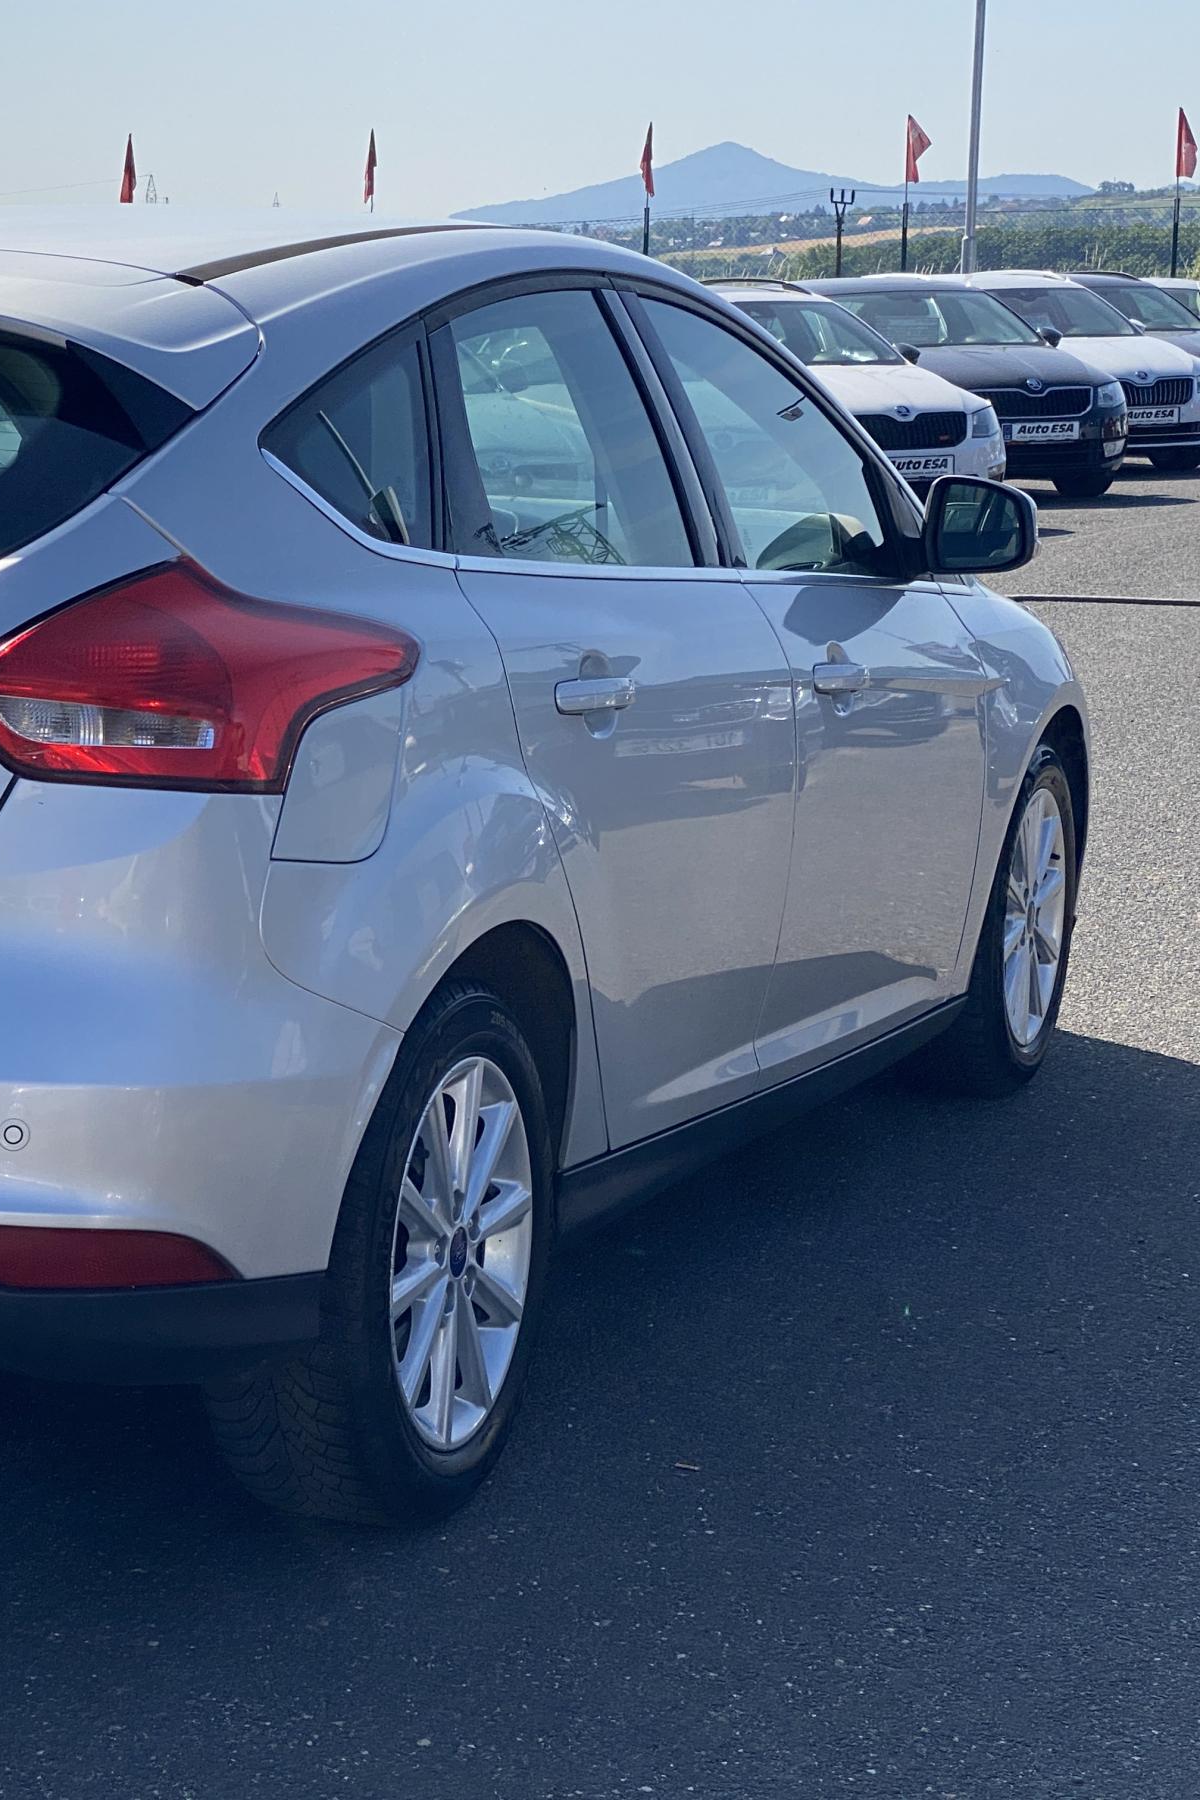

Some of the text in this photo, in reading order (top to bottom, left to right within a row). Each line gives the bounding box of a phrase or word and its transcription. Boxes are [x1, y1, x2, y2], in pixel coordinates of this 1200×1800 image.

[1154, 408, 1175, 418] ESA
[1017, 423, 1074, 435] Auto ESA
[922, 458, 948, 470] ESA
